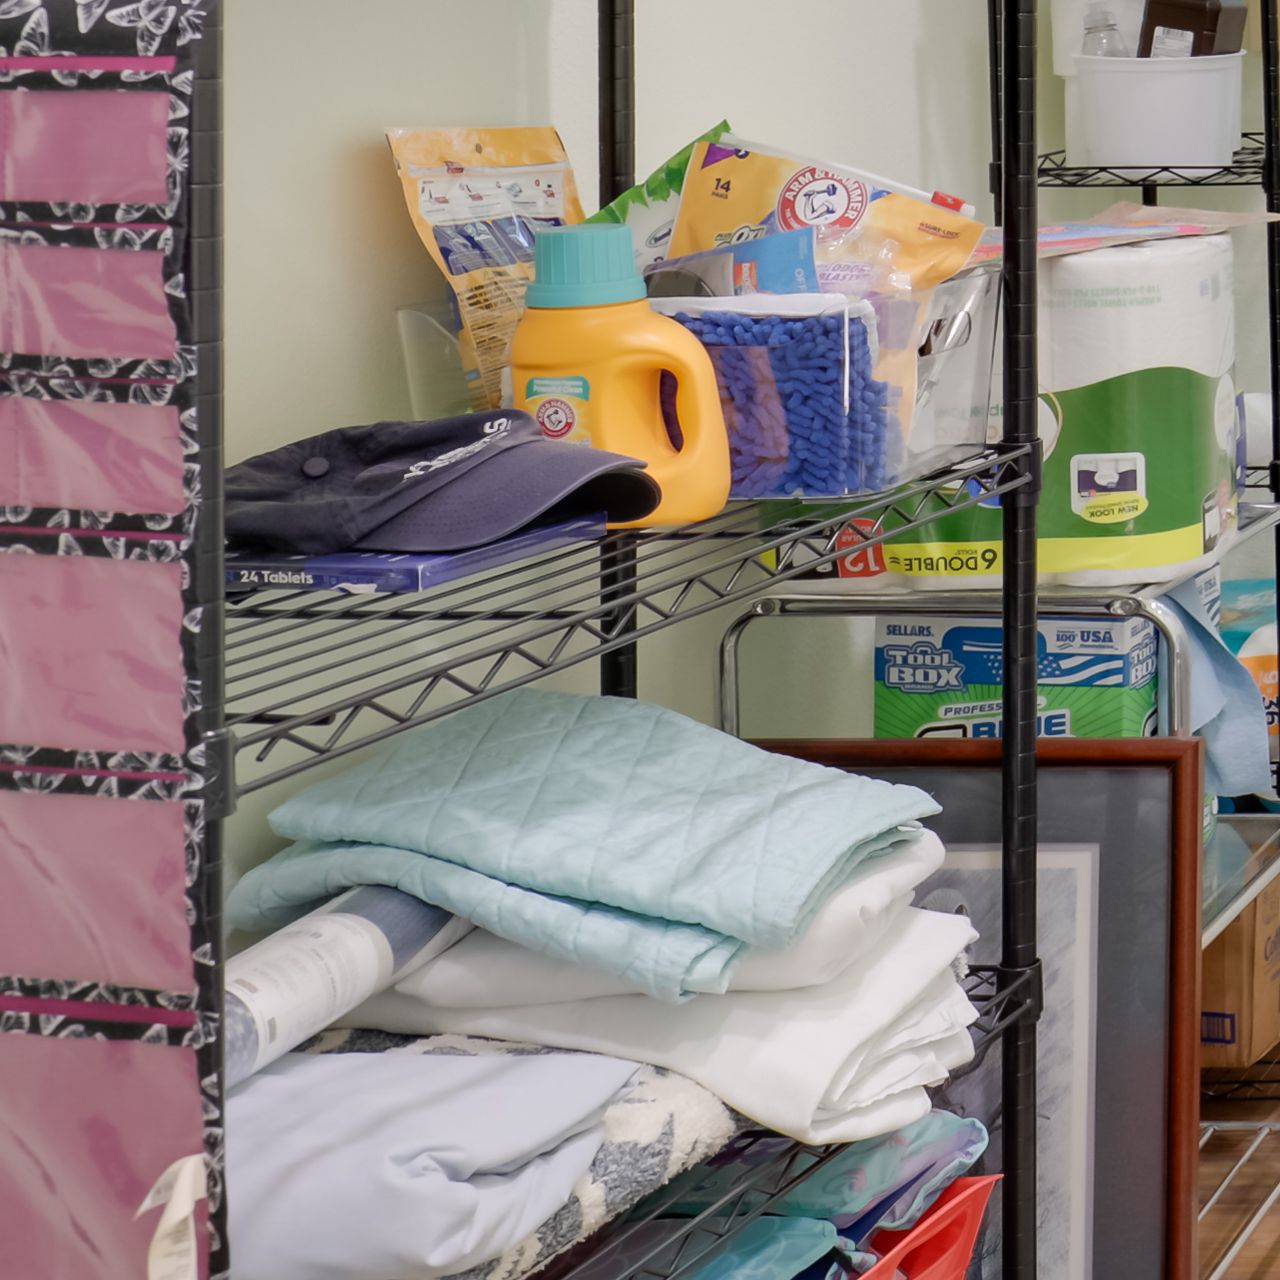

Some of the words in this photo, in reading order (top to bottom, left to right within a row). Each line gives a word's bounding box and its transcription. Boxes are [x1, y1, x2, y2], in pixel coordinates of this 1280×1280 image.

[715, 178, 731, 193] 14
[785, 171, 814, 201] ARM
[1088, 508, 1115, 518] LOOK
[1117, 504, 1139, 514] NEW
[844, 546, 880, 573] 12
[904, 556, 978, 572] DOUBLE
[981, 549, 997, 570] 6
[240, 570, 258, 583] 24
[261, 570, 314, 584] Tablets
[886, 624, 933, 637] SELLARS
[1080, 630, 1114, 644] USA
[889, 667, 962, 687] BOX
